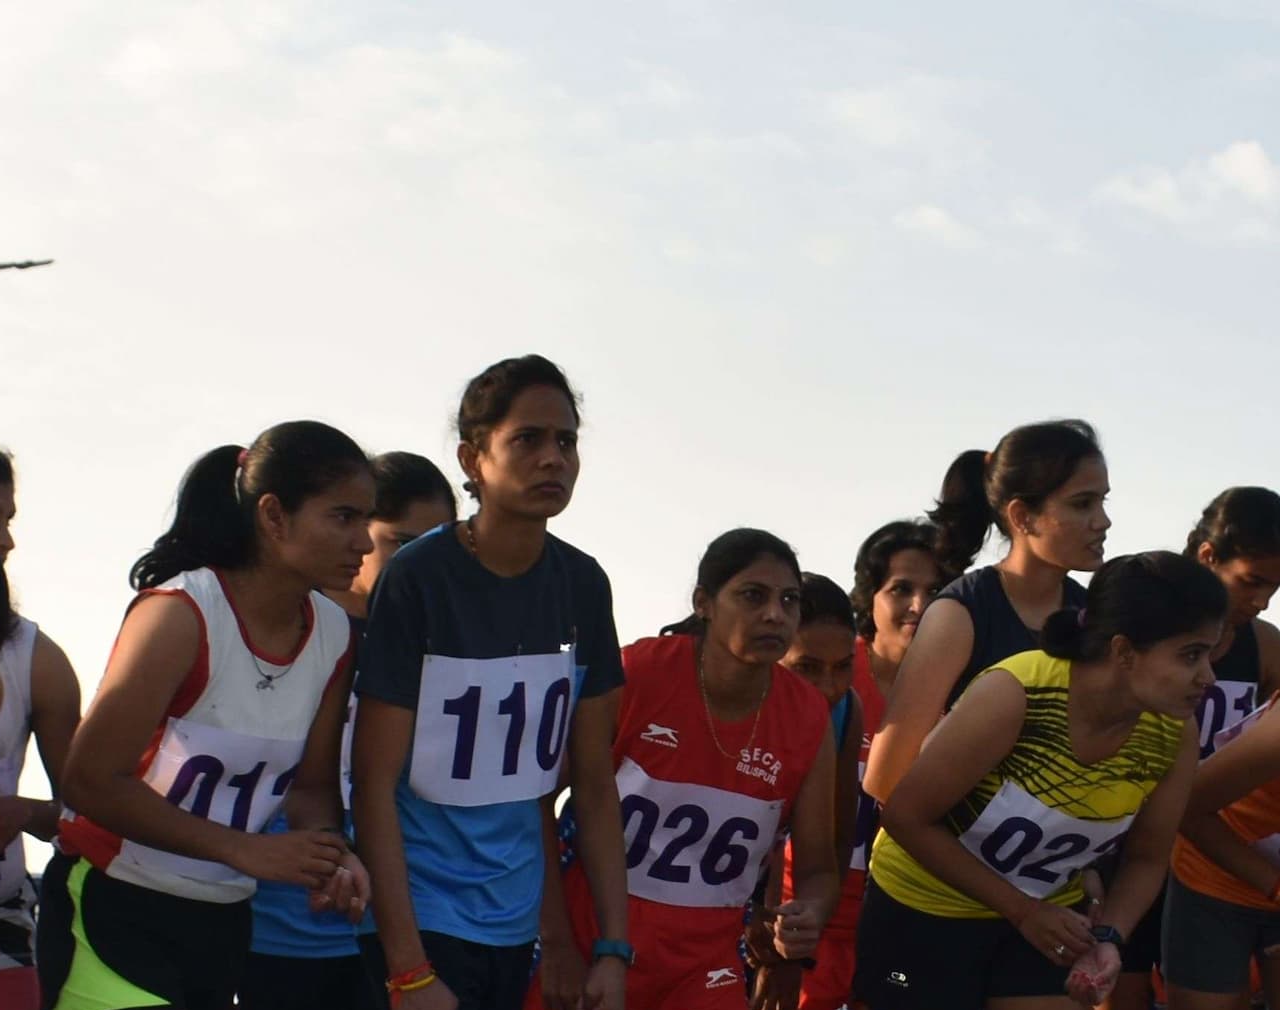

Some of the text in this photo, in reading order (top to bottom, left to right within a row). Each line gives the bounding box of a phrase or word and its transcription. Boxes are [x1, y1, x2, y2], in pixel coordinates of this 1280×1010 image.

[443, 677, 570, 780] 110
[740, 747, 783, 776] SECR
[166, 755, 298, 833] 01
[621, 794, 760, 886] 026
[980, 816, 1128, 884] 02
